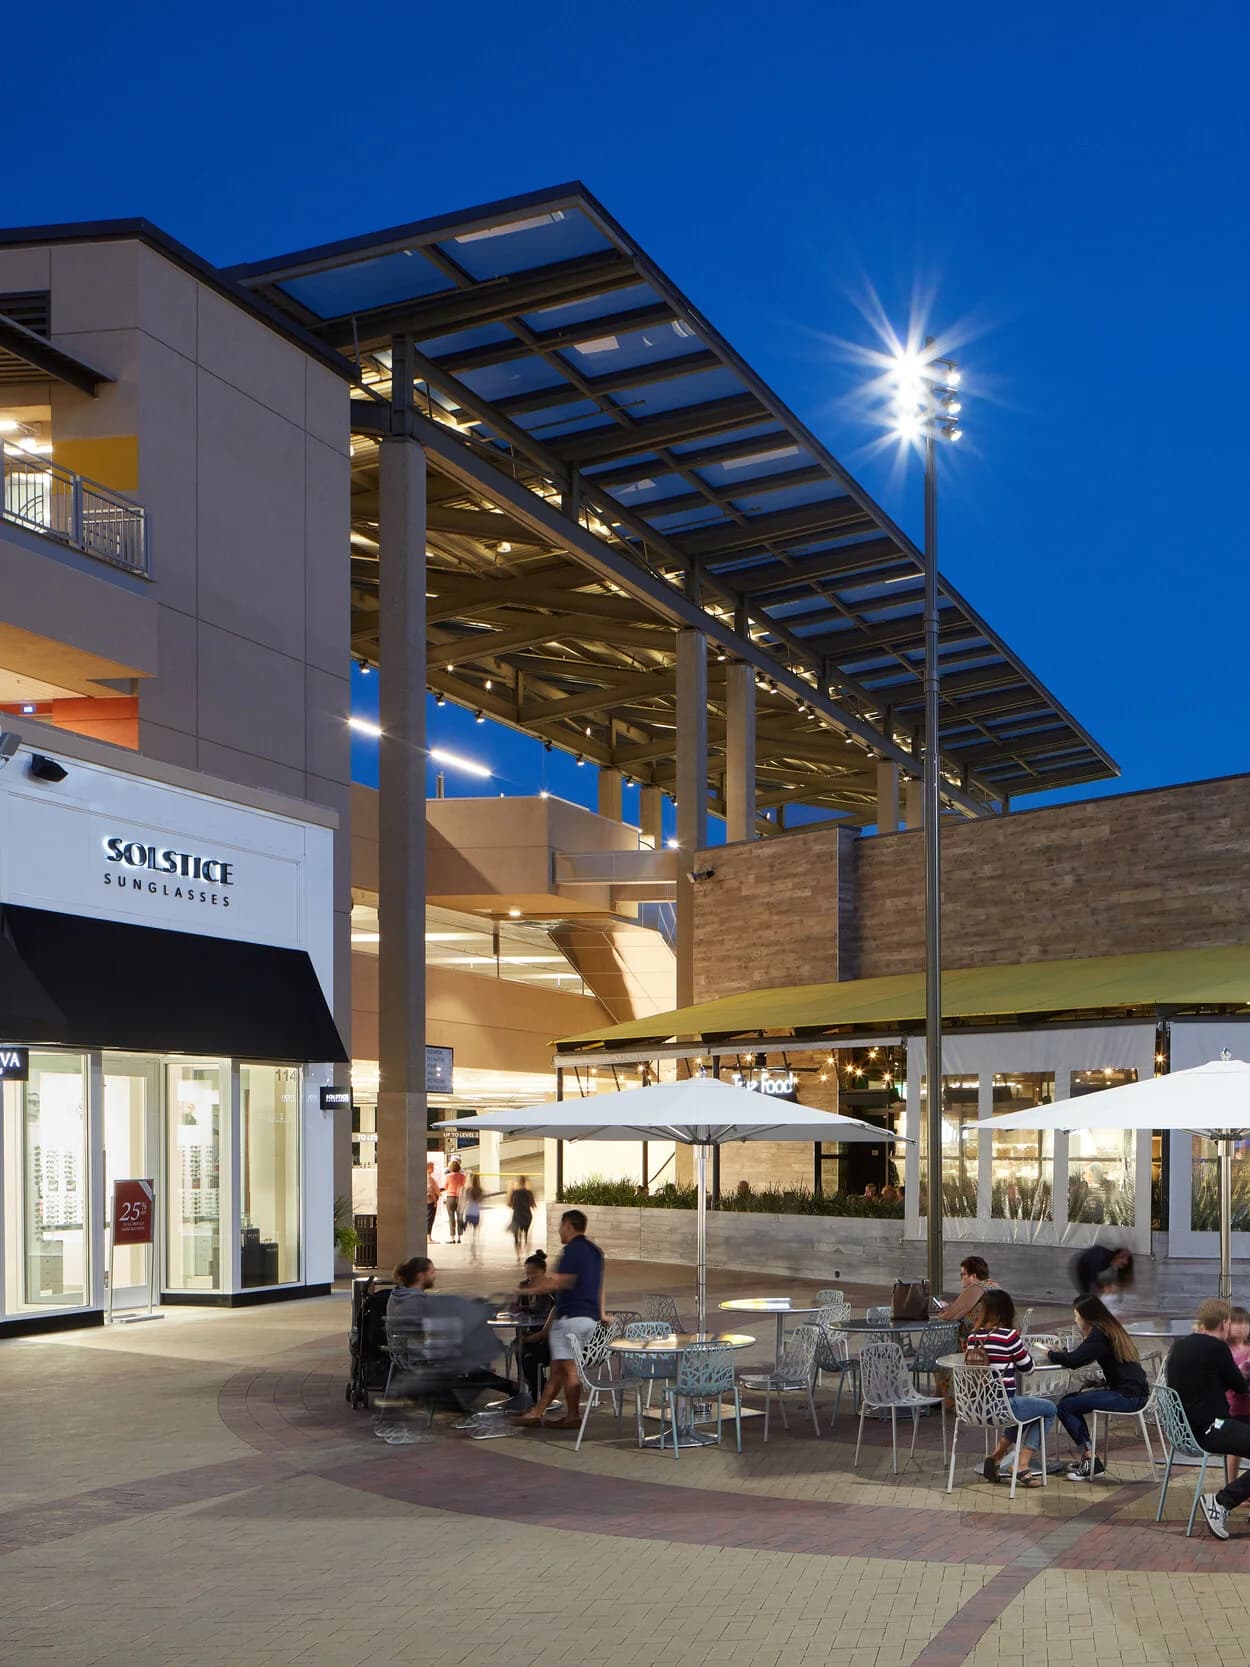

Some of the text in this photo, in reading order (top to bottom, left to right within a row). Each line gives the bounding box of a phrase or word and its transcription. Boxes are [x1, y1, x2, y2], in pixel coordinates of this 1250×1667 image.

[105, 838, 234, 886] SOLSTICE
[104, 873, 230, 907] SUNGLASSES
[275, 1068, 296, 1082] 114
[760, 1072, 794, 1094] Food
